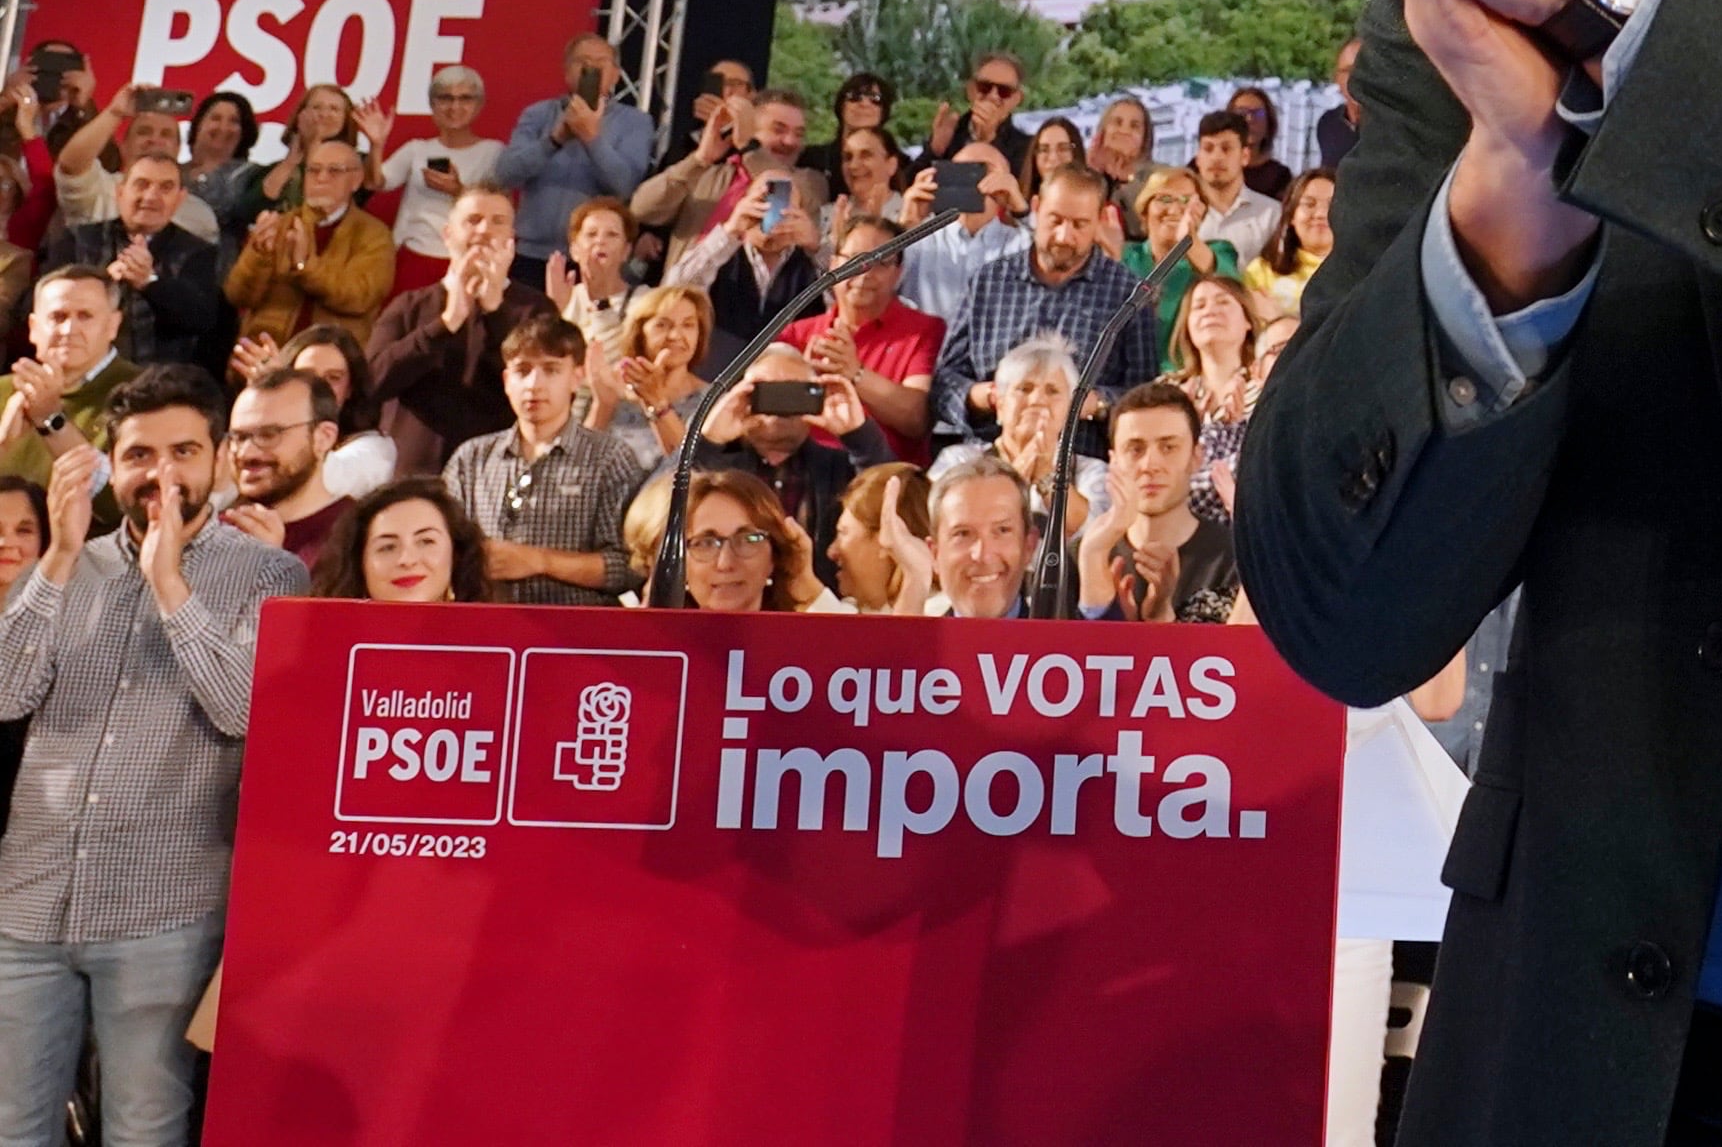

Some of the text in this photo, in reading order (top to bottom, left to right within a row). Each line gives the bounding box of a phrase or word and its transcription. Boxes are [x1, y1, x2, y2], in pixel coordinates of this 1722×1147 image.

[361, 688, 472, 719] Valladolid
[725, 650, 1236, 727] Lo que VOTAS
[353, 727, 494, 783] PSOE
[716, 717, 1267, 858] importa.
[329, 831, 486, 859] 21/05/2023
